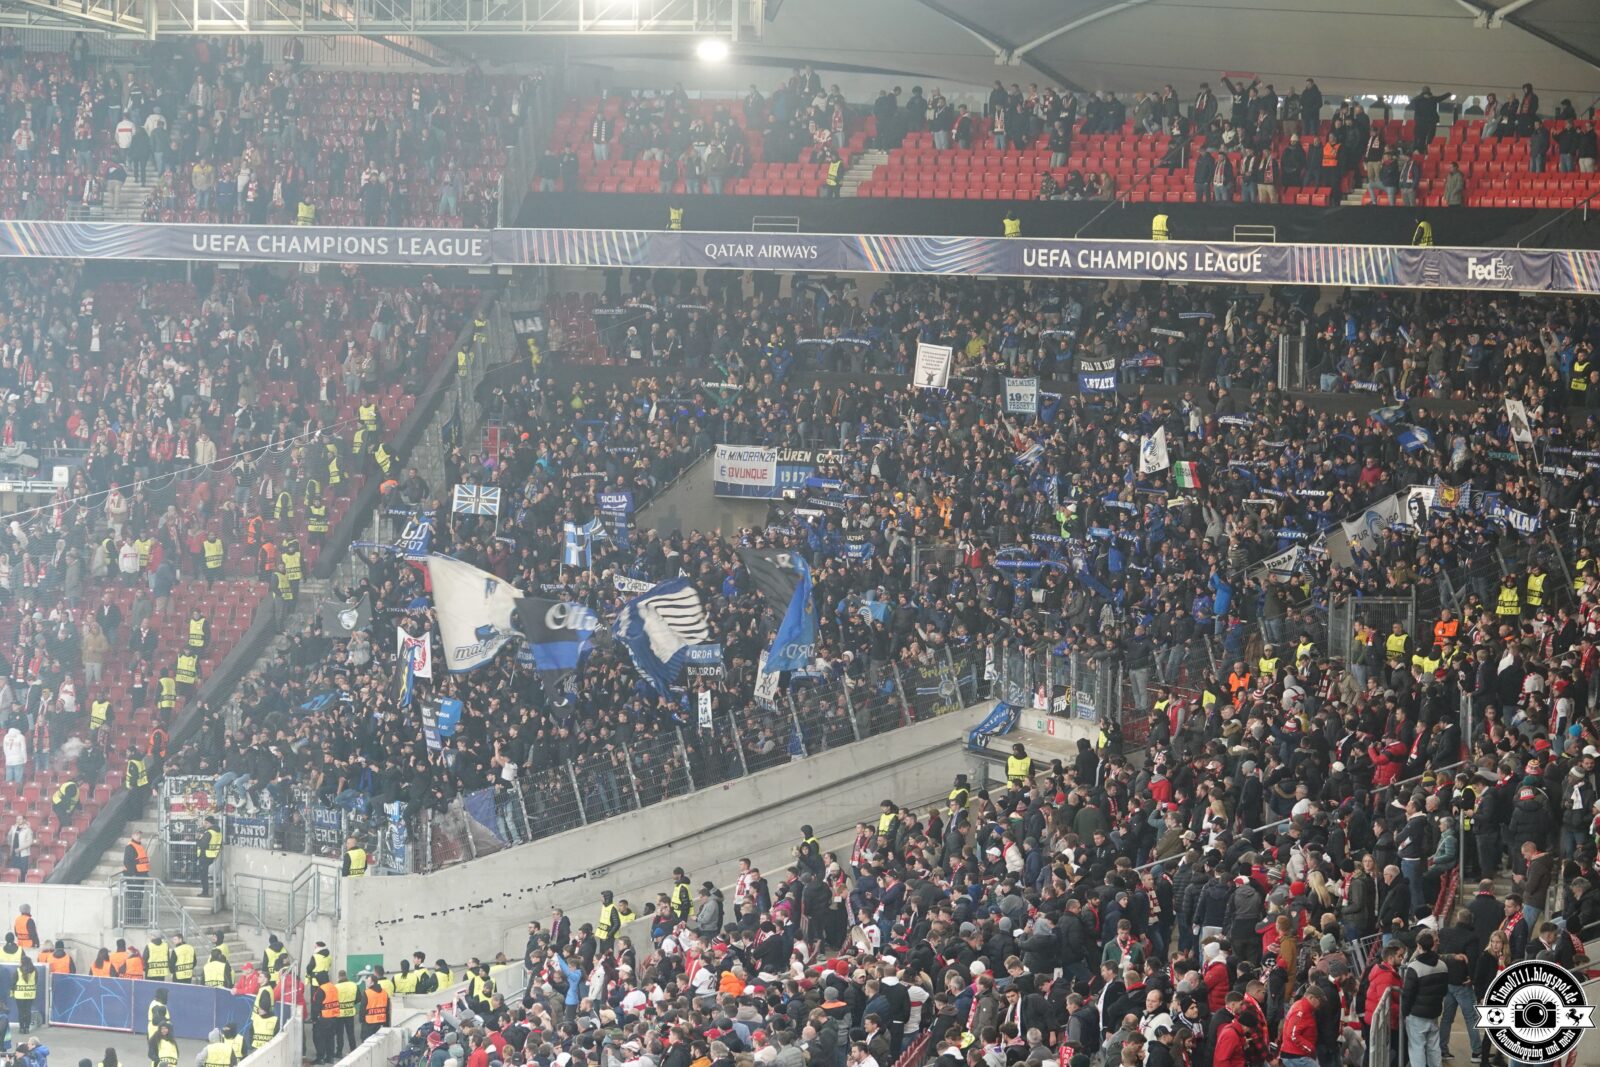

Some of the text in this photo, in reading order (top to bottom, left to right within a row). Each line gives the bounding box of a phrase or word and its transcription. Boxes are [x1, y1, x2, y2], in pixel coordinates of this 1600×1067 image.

[192, 233, 484, 258] UEFA CHAMPIONS LEAGUE
[704, 243, 818, 260] QATAR AIRWAYS
[1023, 248, 1263, 273] UEFA CHAMPIONS LEAGUE
[1467, 257, 1513, 281] FedEx
[728, 451, 776, 463] MINORANZA
[728, 466, 768, 480] OVUNQUE
[691, 649, 713, 660] ORDA
[233, 824, 266, 837] TANTO
